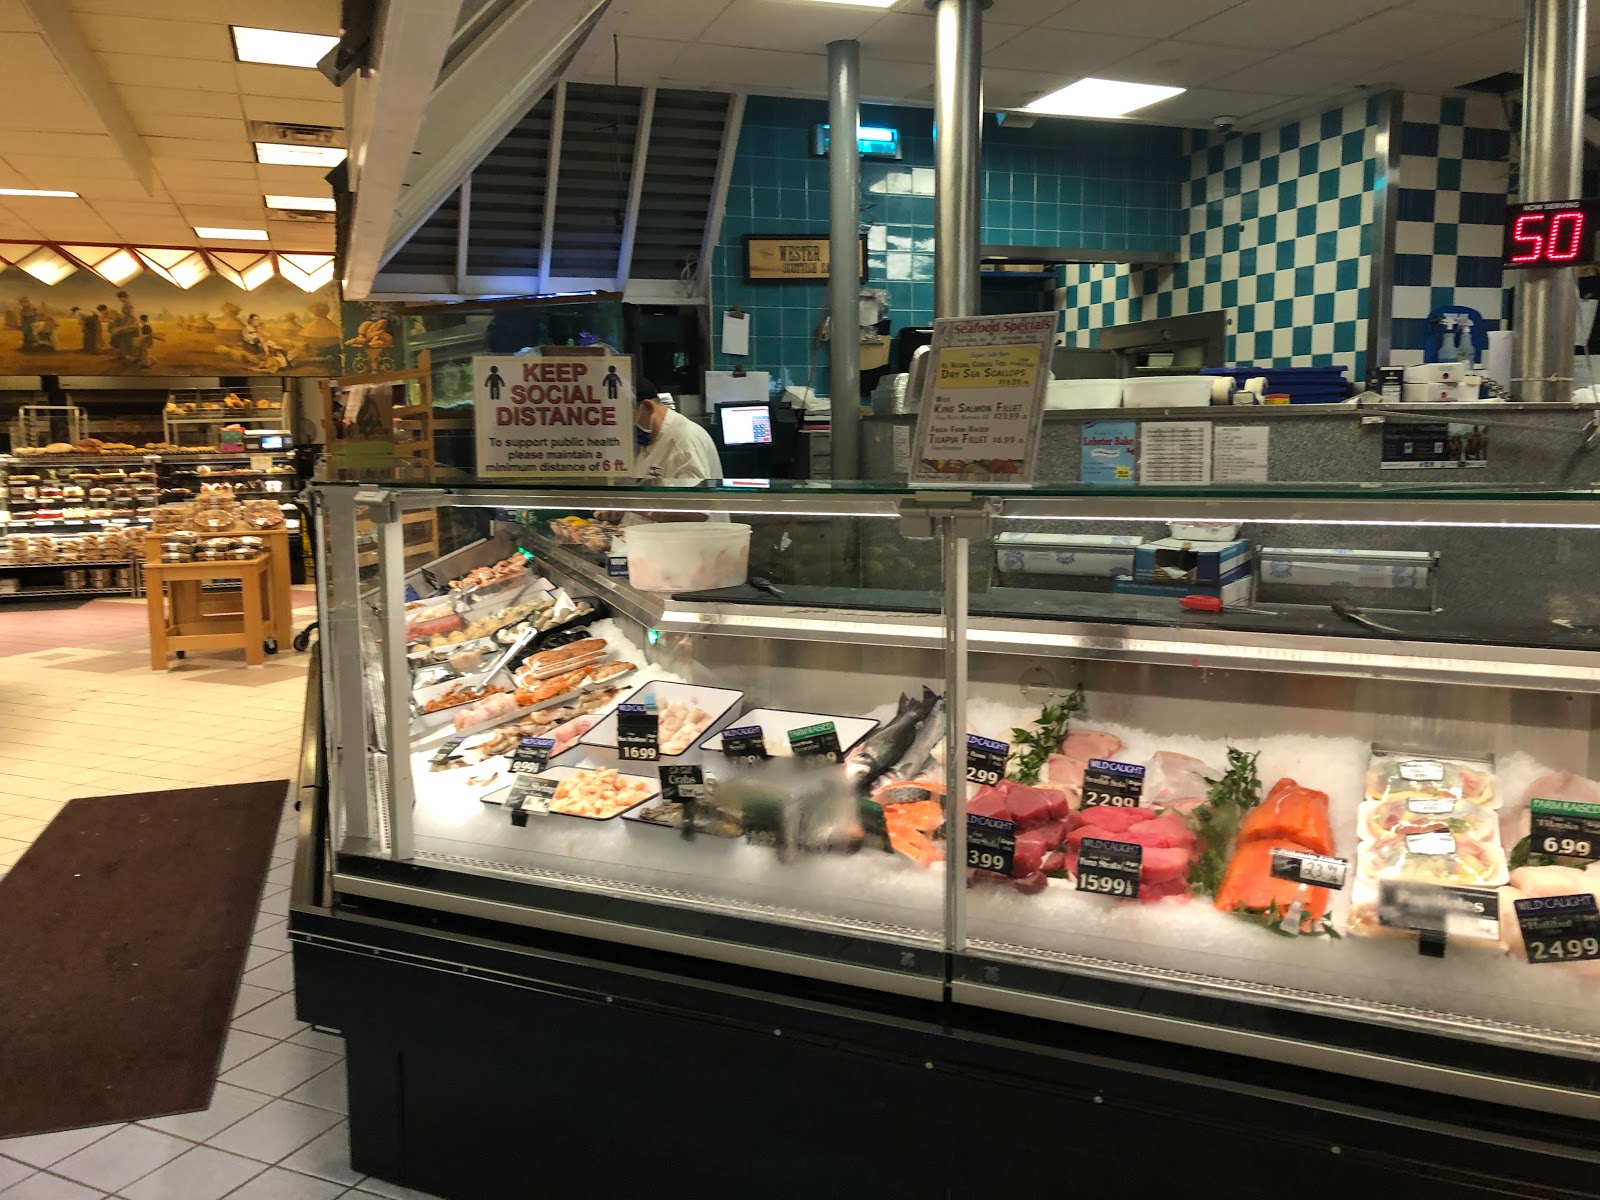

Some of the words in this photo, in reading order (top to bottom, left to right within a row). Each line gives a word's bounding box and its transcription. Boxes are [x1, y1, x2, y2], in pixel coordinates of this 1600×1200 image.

[1512, 212, 1584, 263] 50
[954, 323, 1000, 334] Seafood
[1004, 319, 1050, 334] Specials
[522, 363, 588, 382] KEEP
[941, 370, 960, 379] DRY
[963, 369, 980, 378] SEA
[984, 368, 1026, 378] SCALLOPS
[510, 385, 600, 404] SOCIAL
[934, 403, 955, 413] KING
[958, 402, 992, 413] SALMON
[996, 402, 1022, 412] FILLET
[496, 406, 617, 426] DISTANCE
[489, 438, 502, 448] To
[505, 438, 548, 449] support
[550, 438, 584, 449] public
[586, 438, 620, 447] health
[929, 434, 958, 444] TILAPIA
[962, 434, 988, 444] FILLET
[508, 450, 544, 462] please
[546, 450, 594, 460] maintain
[596, 452, 602, 460] a
[486, 463, 537, 472] minimum
[540, 462, 586, 472] distance
[588, 462, 600, 472] of
[602, 460, 610, 472] 6
[614, 460, 628, 472] ft.
[978, 737, 1009, 752] CAUGHT
[1090, 760, 1109, 769] WILD
[1110, 762, 1144, 774] CAUGHT
[668, 774, 696, 784] Crabs
[978, 816, 1013, 830] CAUGHT
[1083, 839, 1103, 848] WILD
[1104, 842, 1140, 853] CAUGHT
[1518, 900, 1544, 910] WILD
[1544, 896, 1592, 909] CAUGHT
